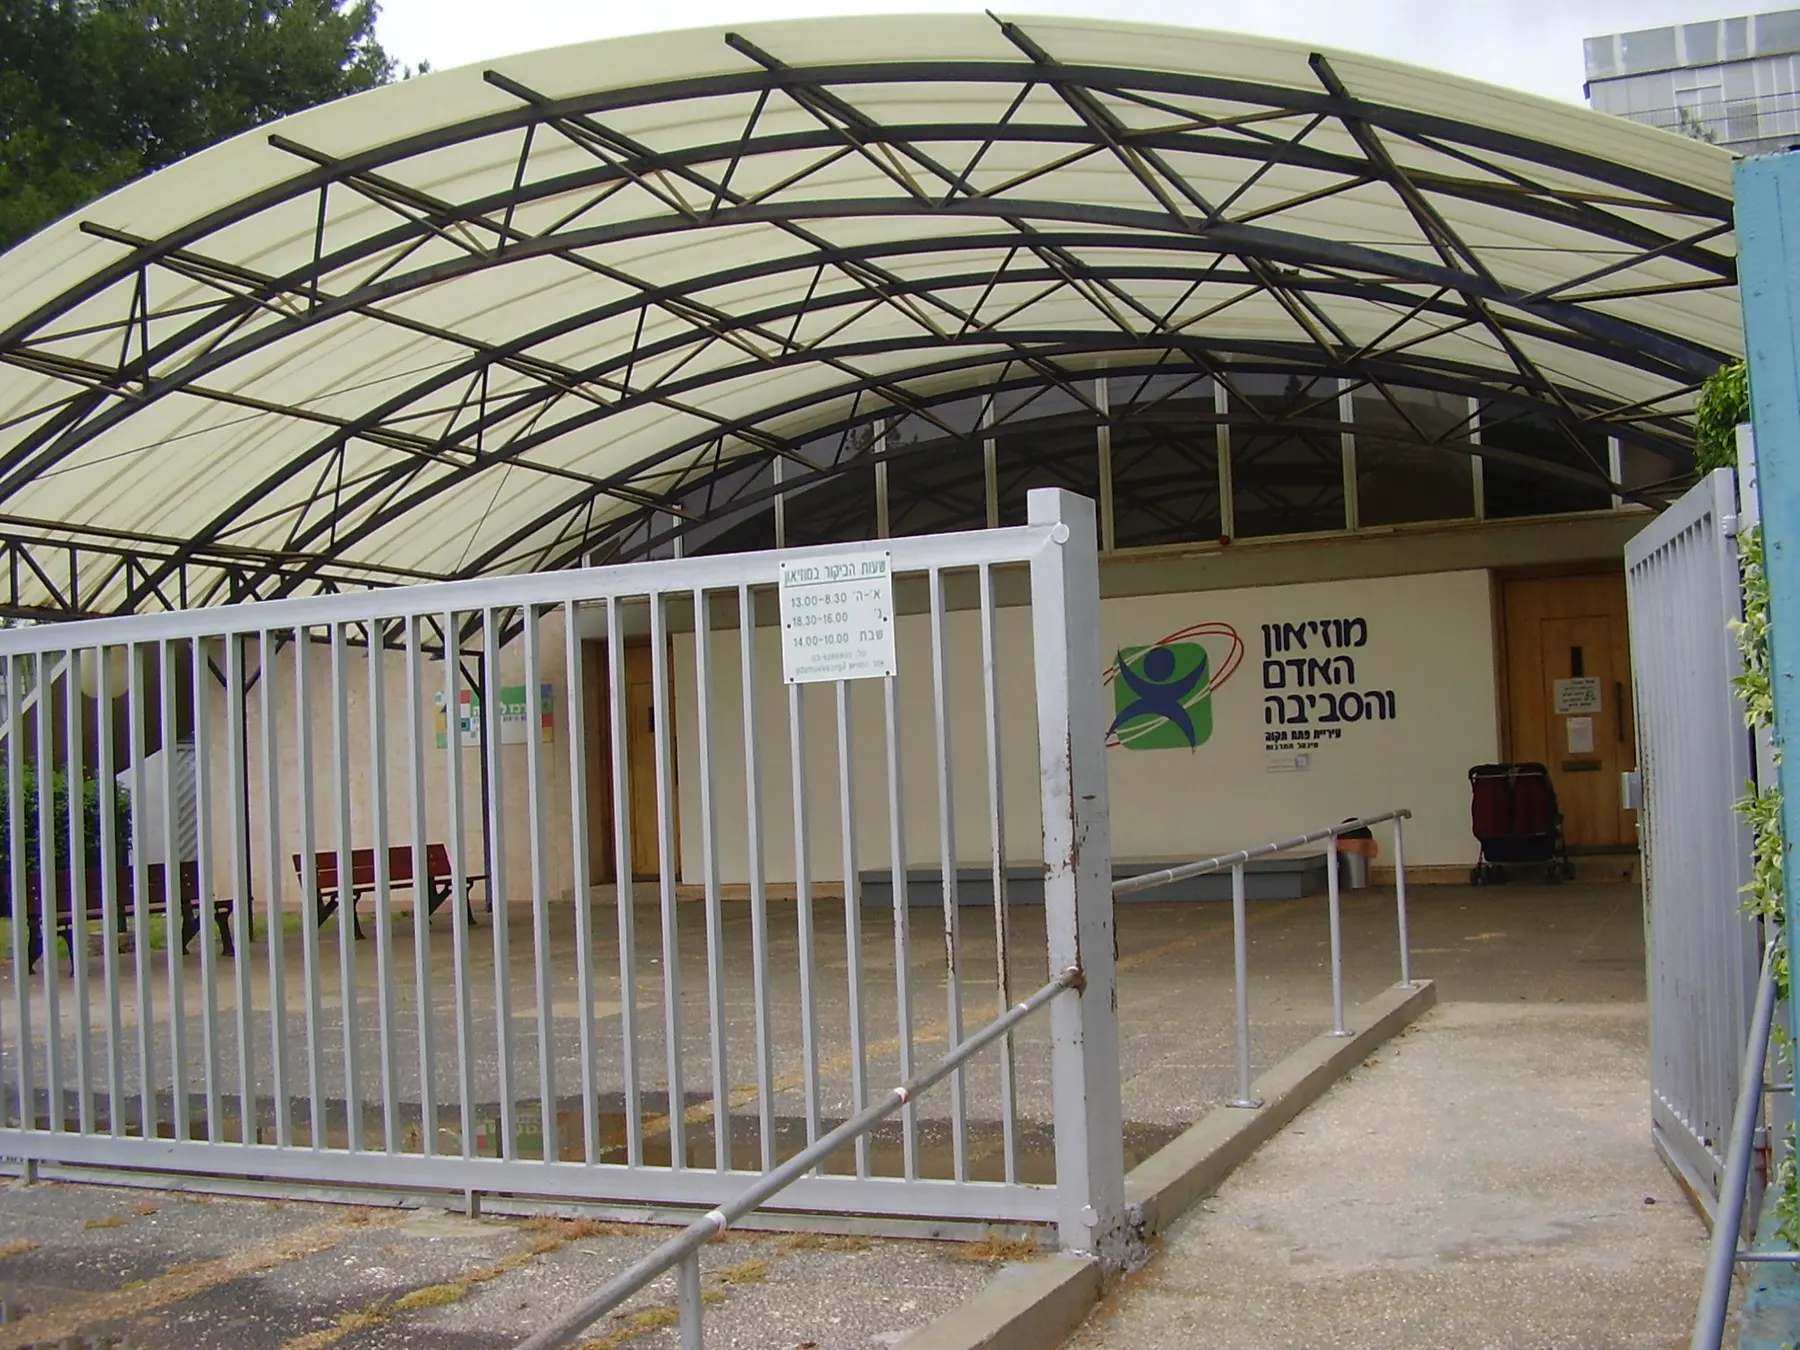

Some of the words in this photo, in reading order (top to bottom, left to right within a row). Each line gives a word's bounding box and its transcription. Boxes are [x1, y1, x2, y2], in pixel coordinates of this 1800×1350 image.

[784, 567, 820, 586] במוזיאון
[824, 563, 856, 581] הביקור
[861, 560, 886, 575] שעות
[859, 629, 884, 642] שבת
[1261, 617, 1368, 658] מוזיאון
[1263, 656, 1355, 689] האדם
[1264, 690, 1396, 725] והסביבה
[1291, 730, 1311, 741] פתח
[1313, 728, 1341, 740] עיריית
